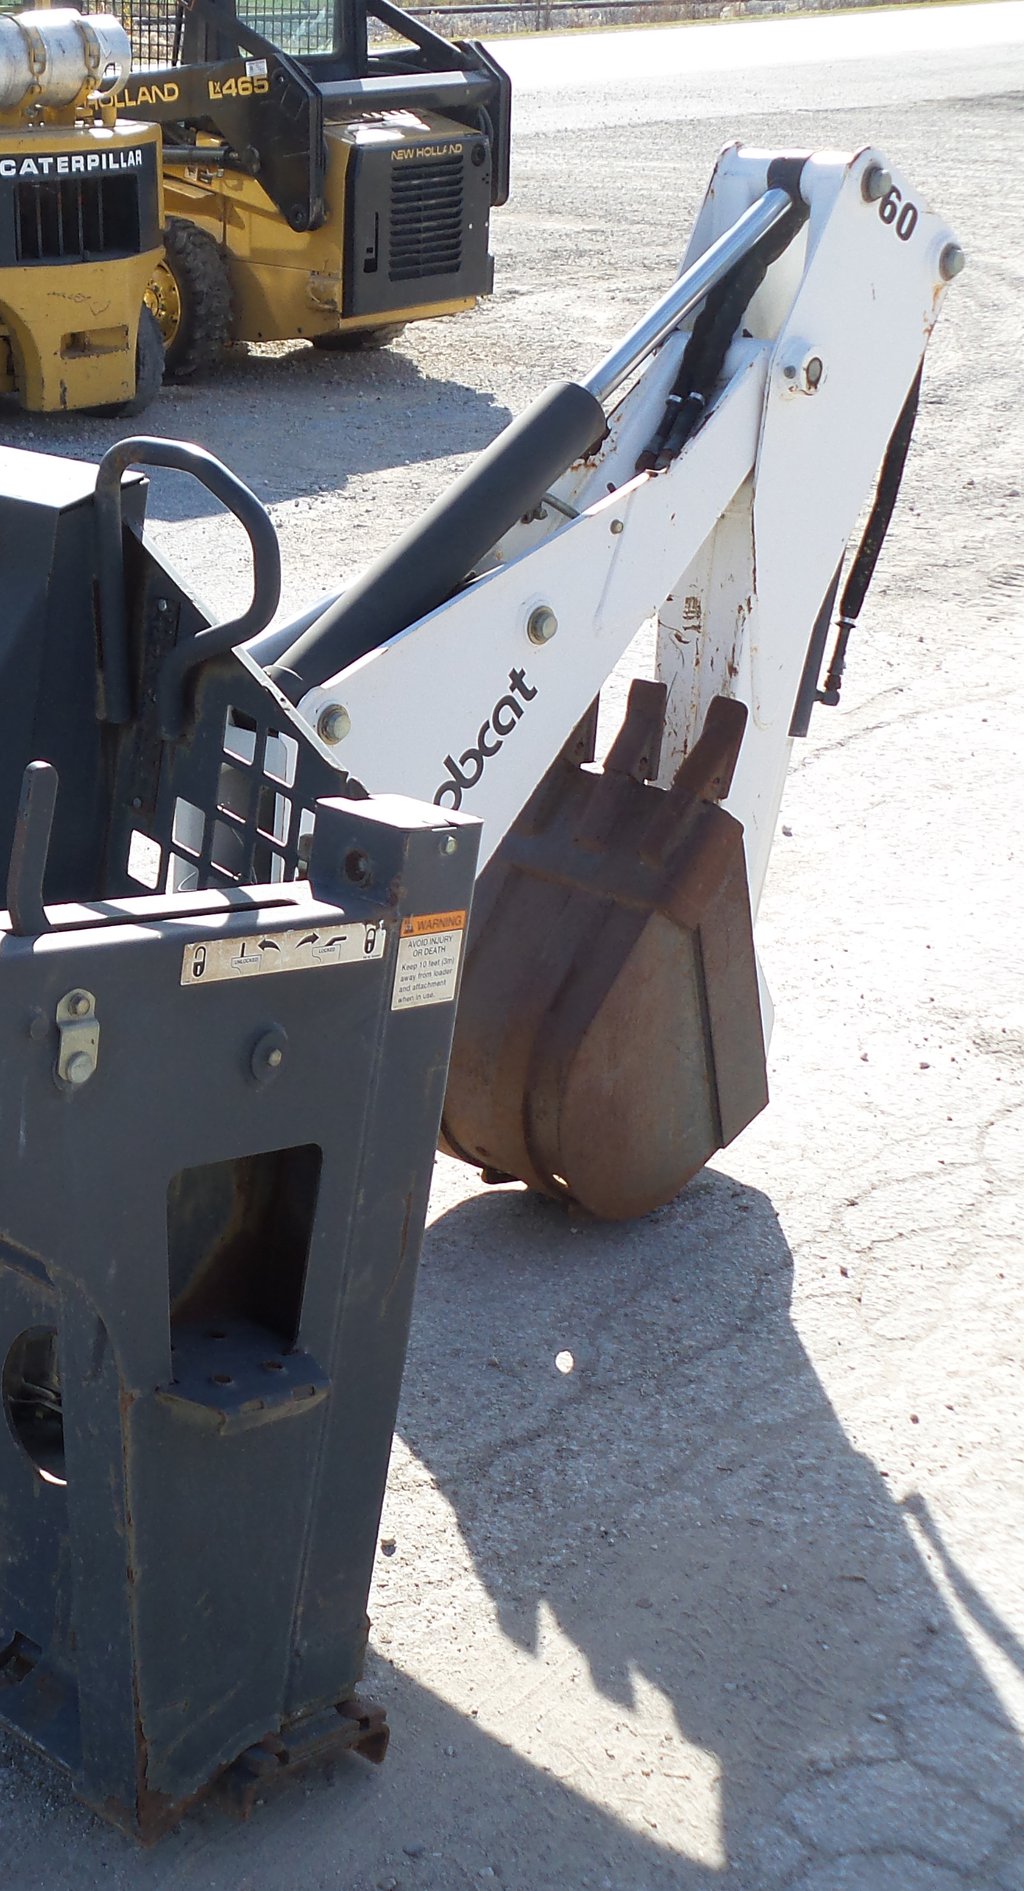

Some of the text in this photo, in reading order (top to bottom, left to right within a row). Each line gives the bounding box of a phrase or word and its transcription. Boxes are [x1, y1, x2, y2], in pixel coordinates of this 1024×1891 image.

[391, 143, 463, 160] NEW HOLLAND
[0, 149, 143, 177] CATERPILLAR
[879, 184, 918, 241] 60
[433, 667, 539, 811] obcat
[417, 914, 461, 931] WARNING
[408, 934, 453, 948] AVOID INJURY
[319, 946, 336, 955] LOCKED
[413, 945, 445, 957] OR DEATH
[234, 957, 259, 966] UNLOCKED
[402, 962, 417, 972] Keep
[419, 961, 426, 969] 10
[428, 958, 439, 967] feet
[400, 974, 415, 982] away
[434, 968, 452, 977] loader
[412, 979, 446, 990] attachment
[398, 995, 413, 1003] when
